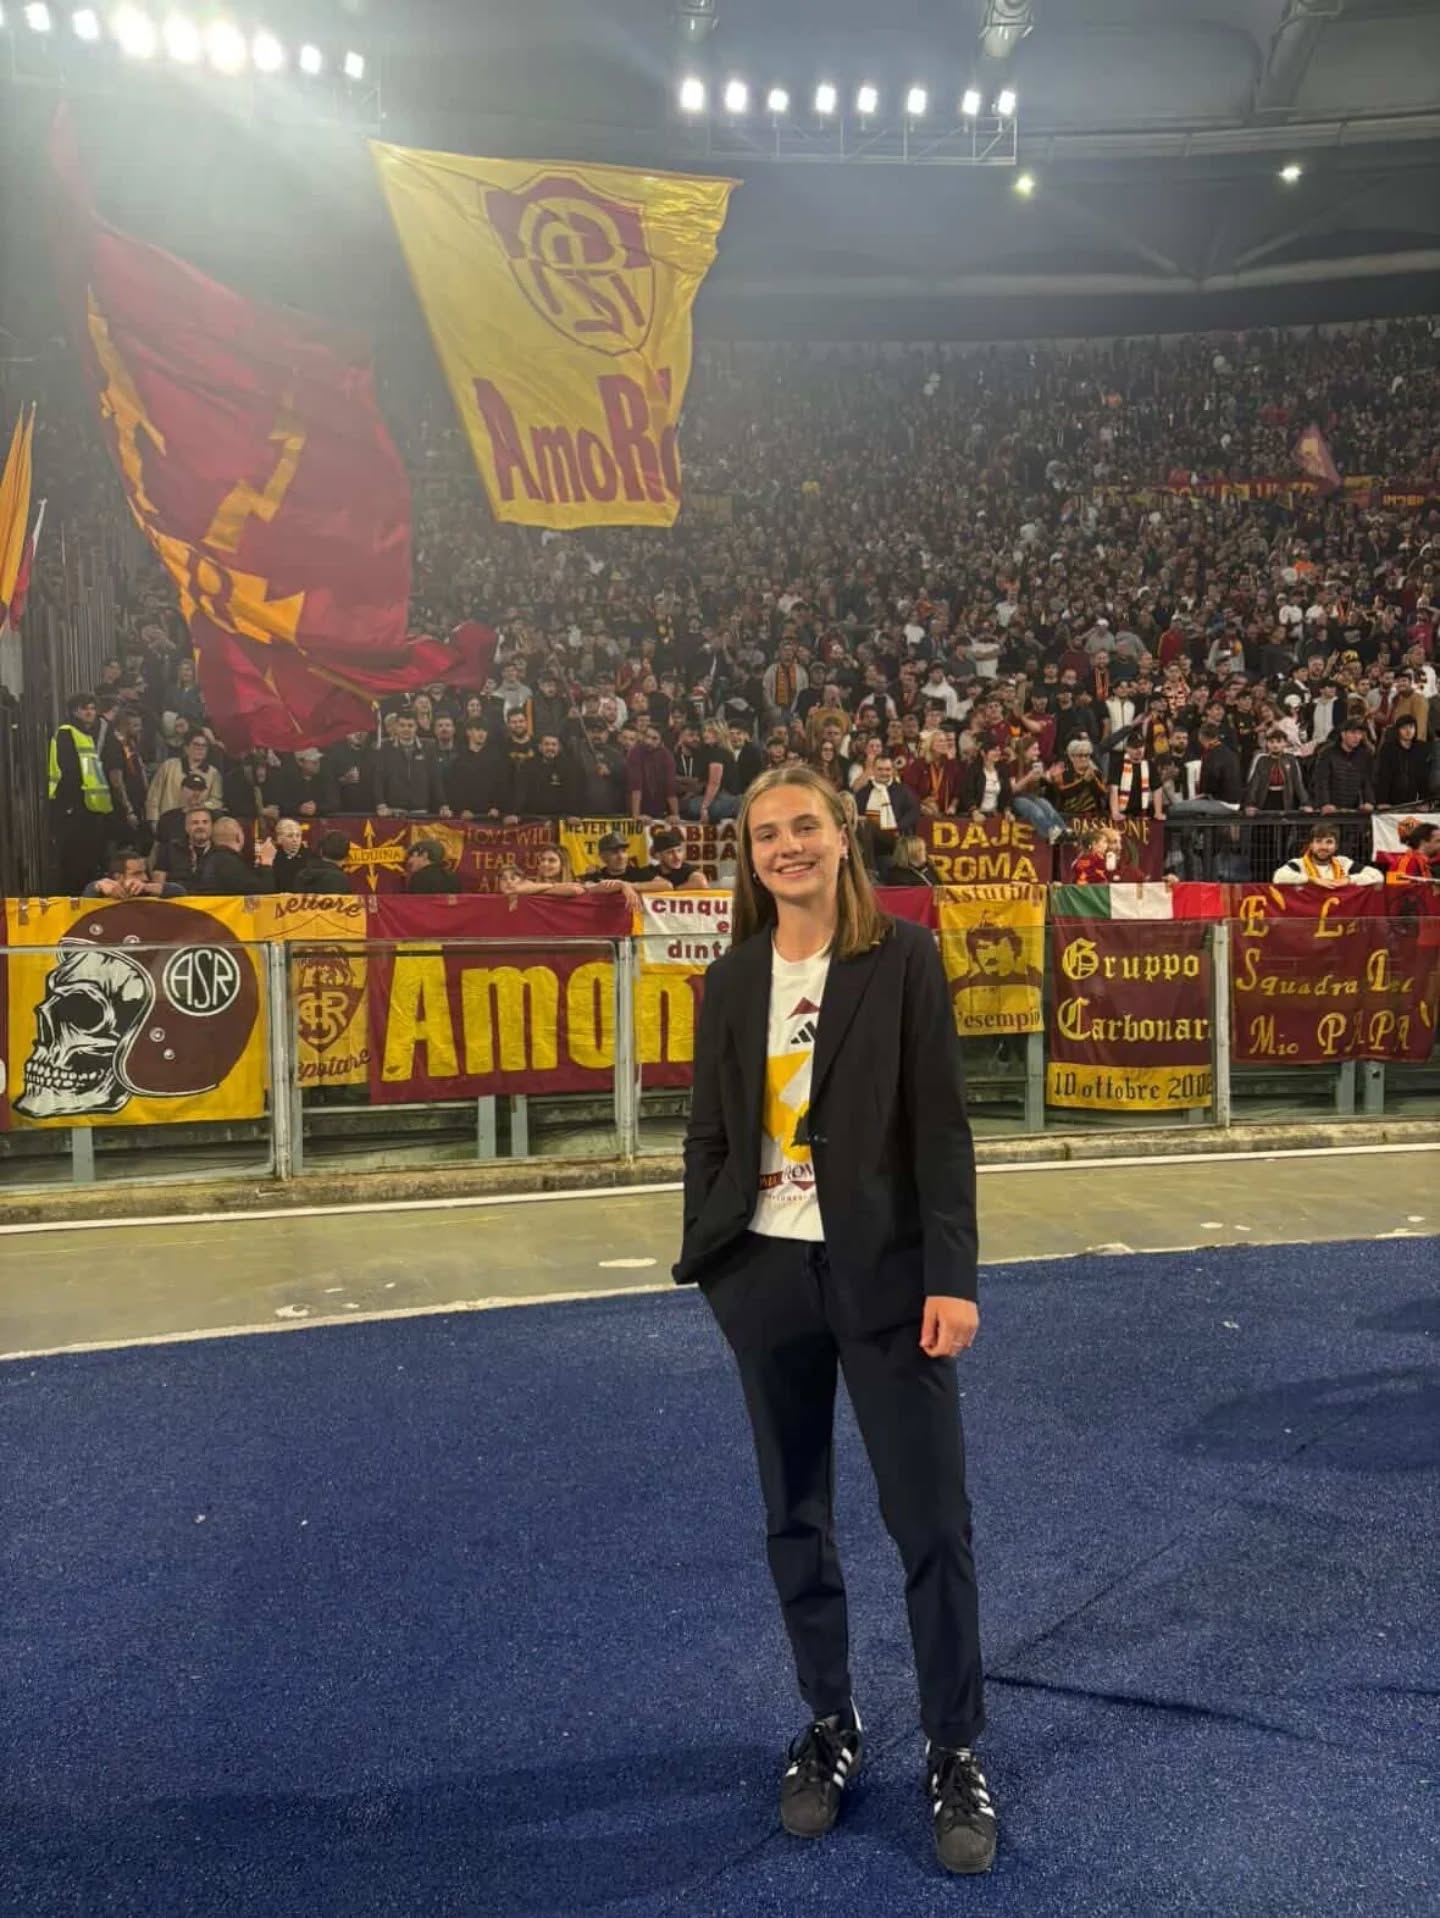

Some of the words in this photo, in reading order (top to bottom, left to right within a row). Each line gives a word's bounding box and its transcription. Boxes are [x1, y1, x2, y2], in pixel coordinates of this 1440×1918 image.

[932, 821, 1034, 851] DAJE
[929, 853, 1039, 883] ROMA
[651, 899, 728, 916] cinqu
[717, 921, 730, 933] e
[667, 938, 722, 959] dint
[1062, 937, 1200, 983] Gruppo
[170, 949, 233, 1009] ASR
[1235, 948, 1359, 996] Squadra
[1249, 1014, 1299, 1056] Mio
[1054, 1071, 1077, 1096] 10
[1082, 1075, 1161, 1100] ottobre
